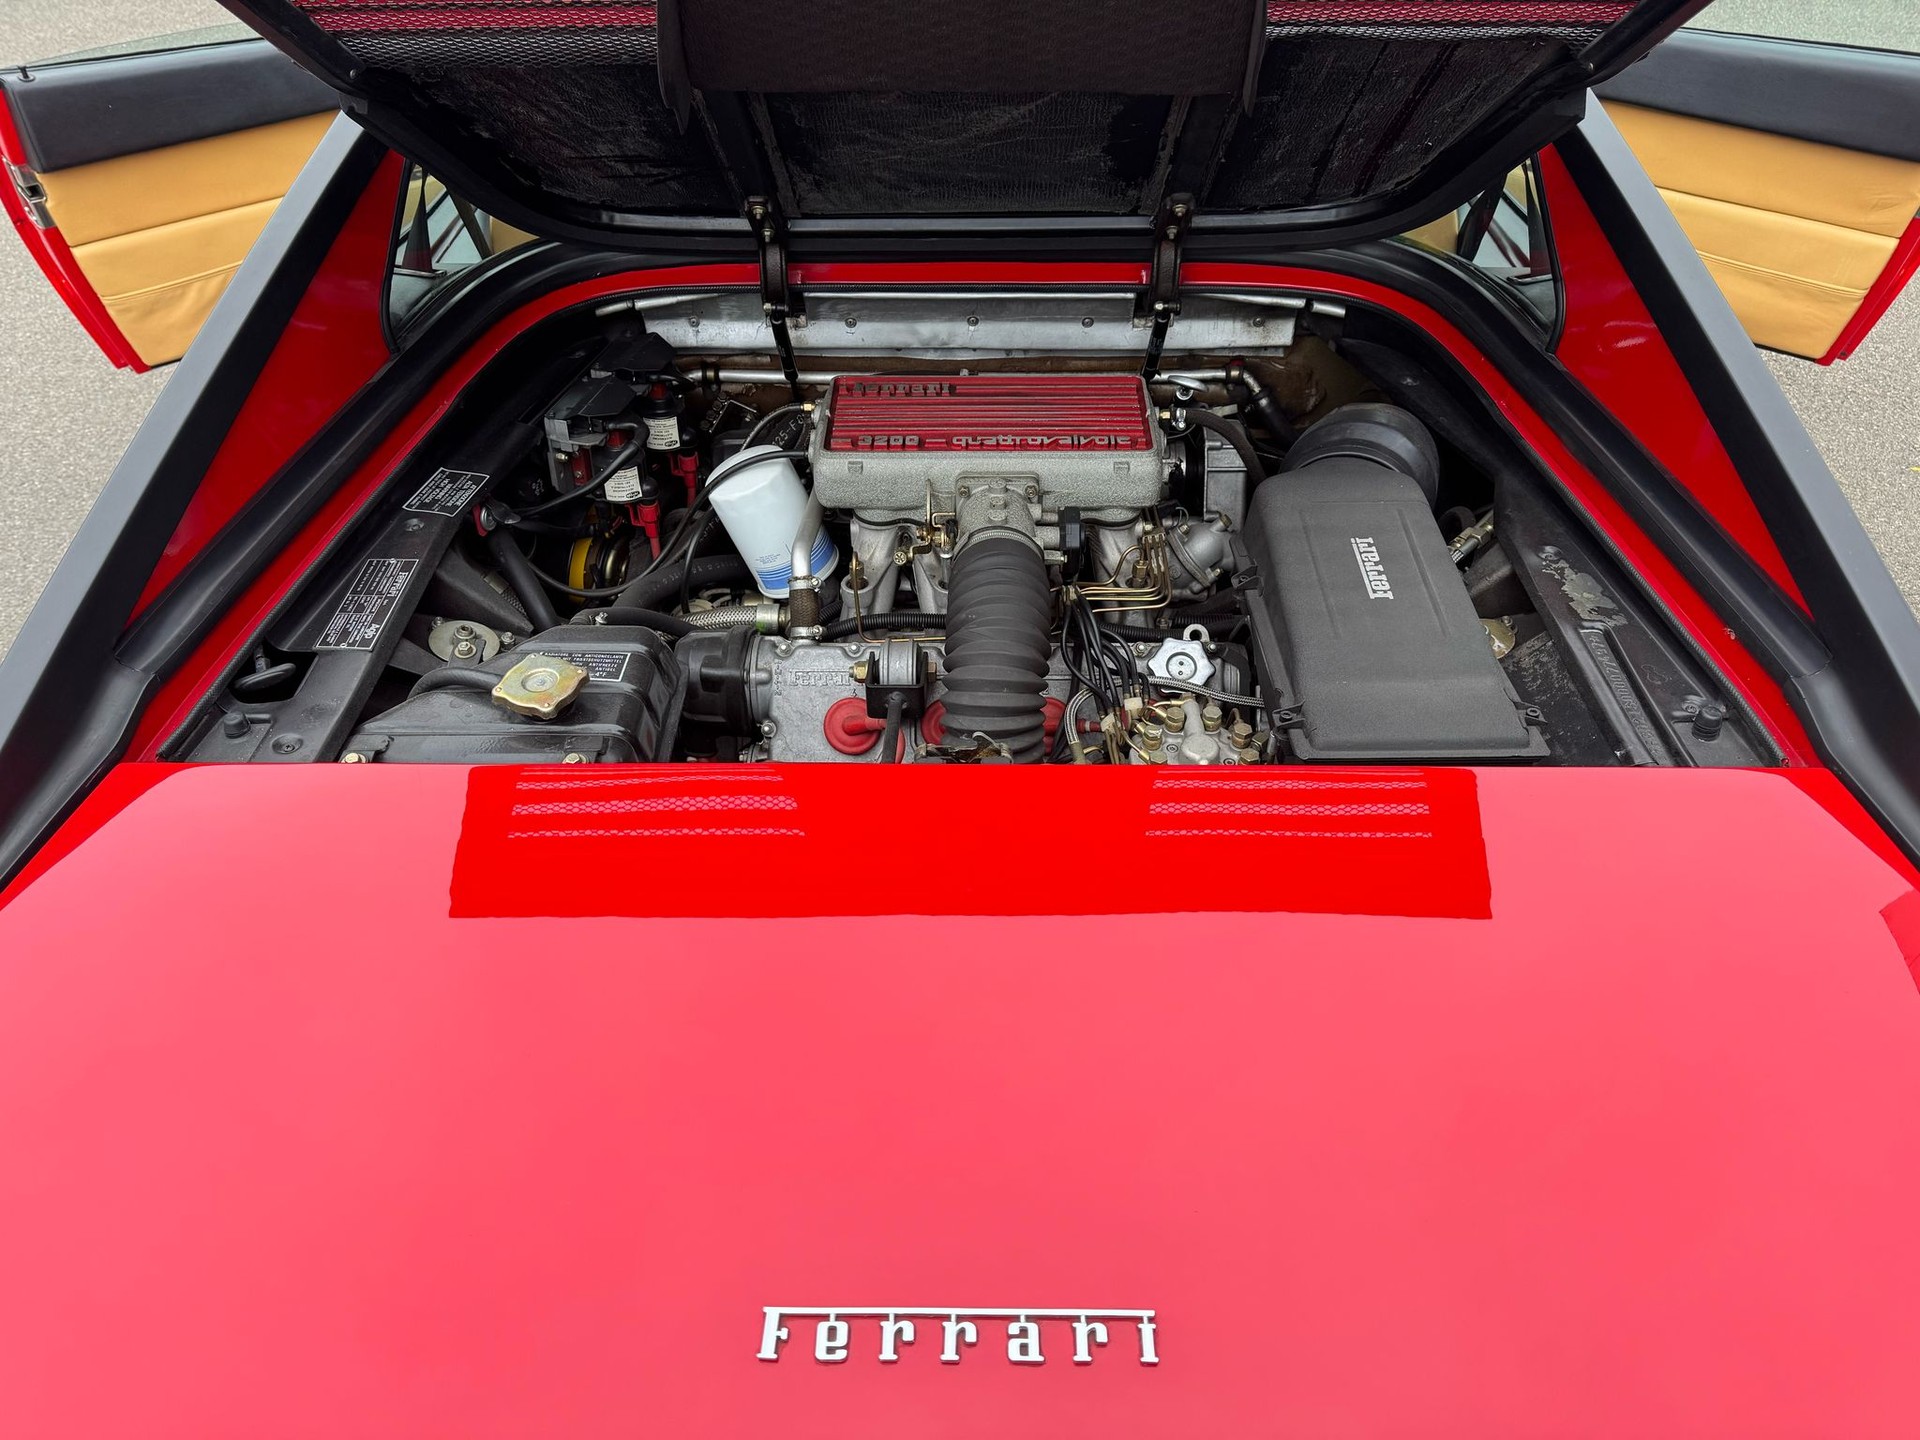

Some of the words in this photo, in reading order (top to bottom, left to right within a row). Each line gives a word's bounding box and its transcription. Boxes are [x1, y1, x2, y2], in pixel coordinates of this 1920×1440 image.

[858, 435, 919, 447] 3200
[952, 435, 1132, 448] quattrovalvole
[1350, 537, 1394, 599] Ferrari
[387, 572, 409, 597] Ferrari
[788, 669, 862, 687] Ferrar
[756, 1306, 1160, 1365] Ferrari
